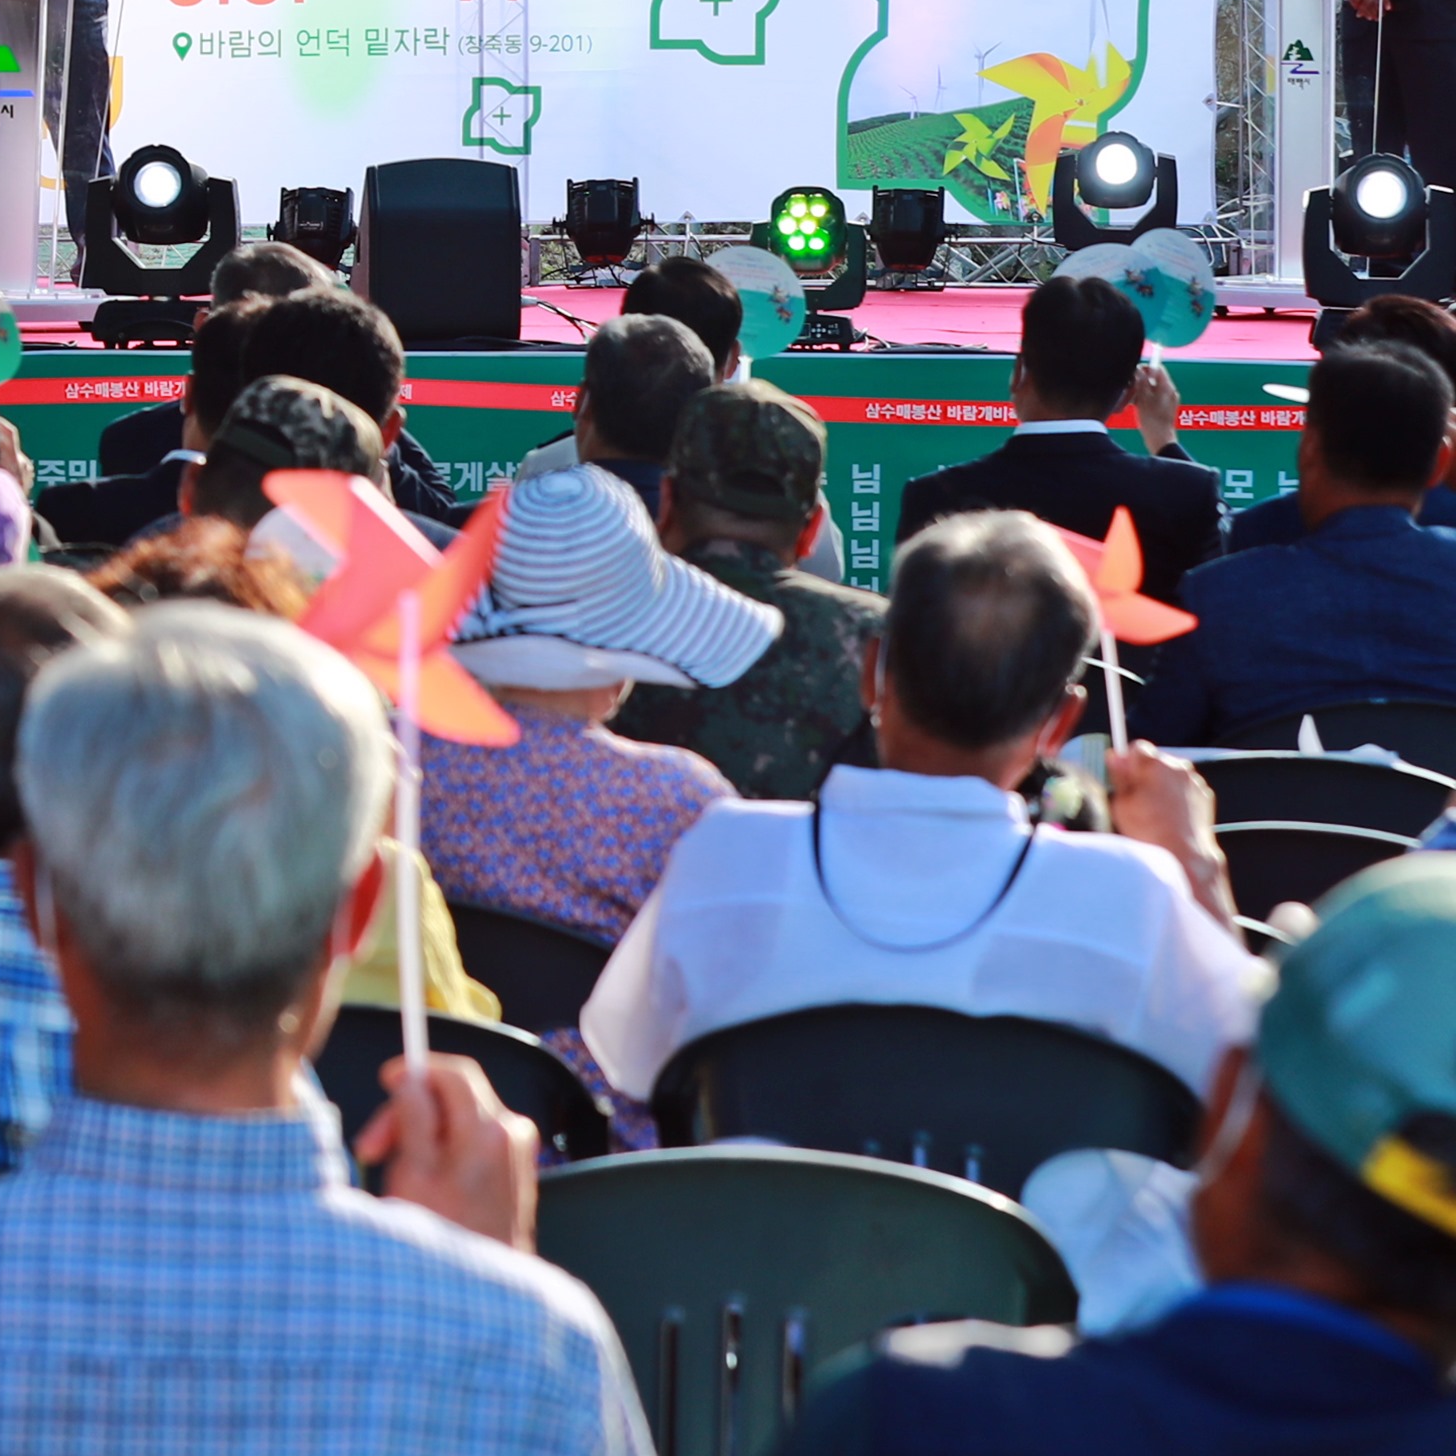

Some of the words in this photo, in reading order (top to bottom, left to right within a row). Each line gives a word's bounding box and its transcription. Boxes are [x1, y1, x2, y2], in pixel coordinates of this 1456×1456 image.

[199, 29, 282, 59] 바람의
[295, 27, 350, 58] 언덕
[364, 27, 450, 57] 밑자락
[457, 34, 522, 57] (창죽동
[529, 34, 593, 57] 9-201)
[64, 381, 139, 399] 삼수매봉산
[865, 402, 942, 421] 삼수매봉산
[1179, 410, 1256, 426] 삼수매봉산
[851, 463, 881, 495] 님
[851, 501, 880, 532] 님
[850, 539, 879, 569] 님
